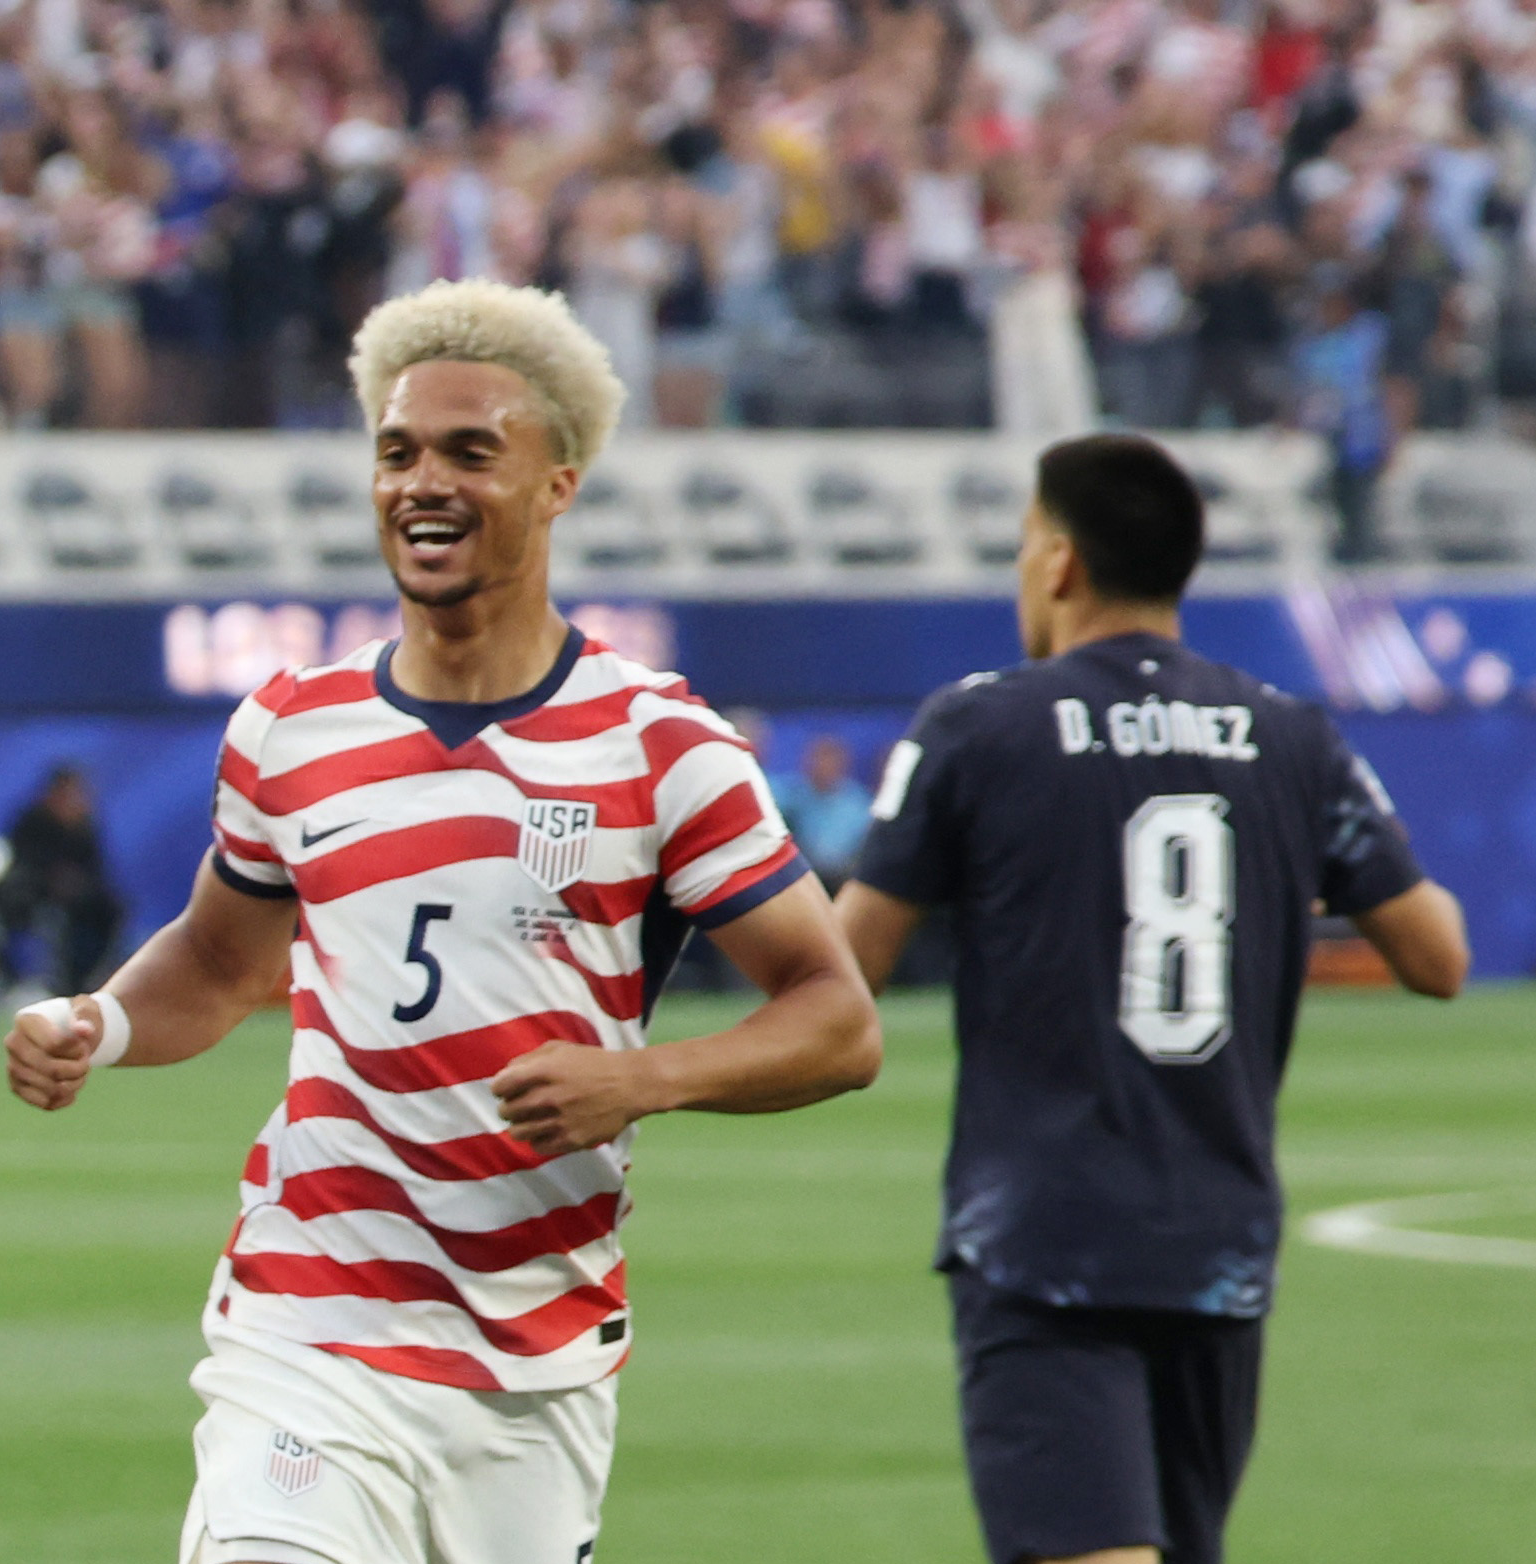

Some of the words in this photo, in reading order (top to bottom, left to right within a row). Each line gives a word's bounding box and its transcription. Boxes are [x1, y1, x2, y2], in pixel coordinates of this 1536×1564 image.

[528, 804, 589, 838] USA
[393, 904, 454, 1022] 5
[1119, 793, 1235, 1065] 8
